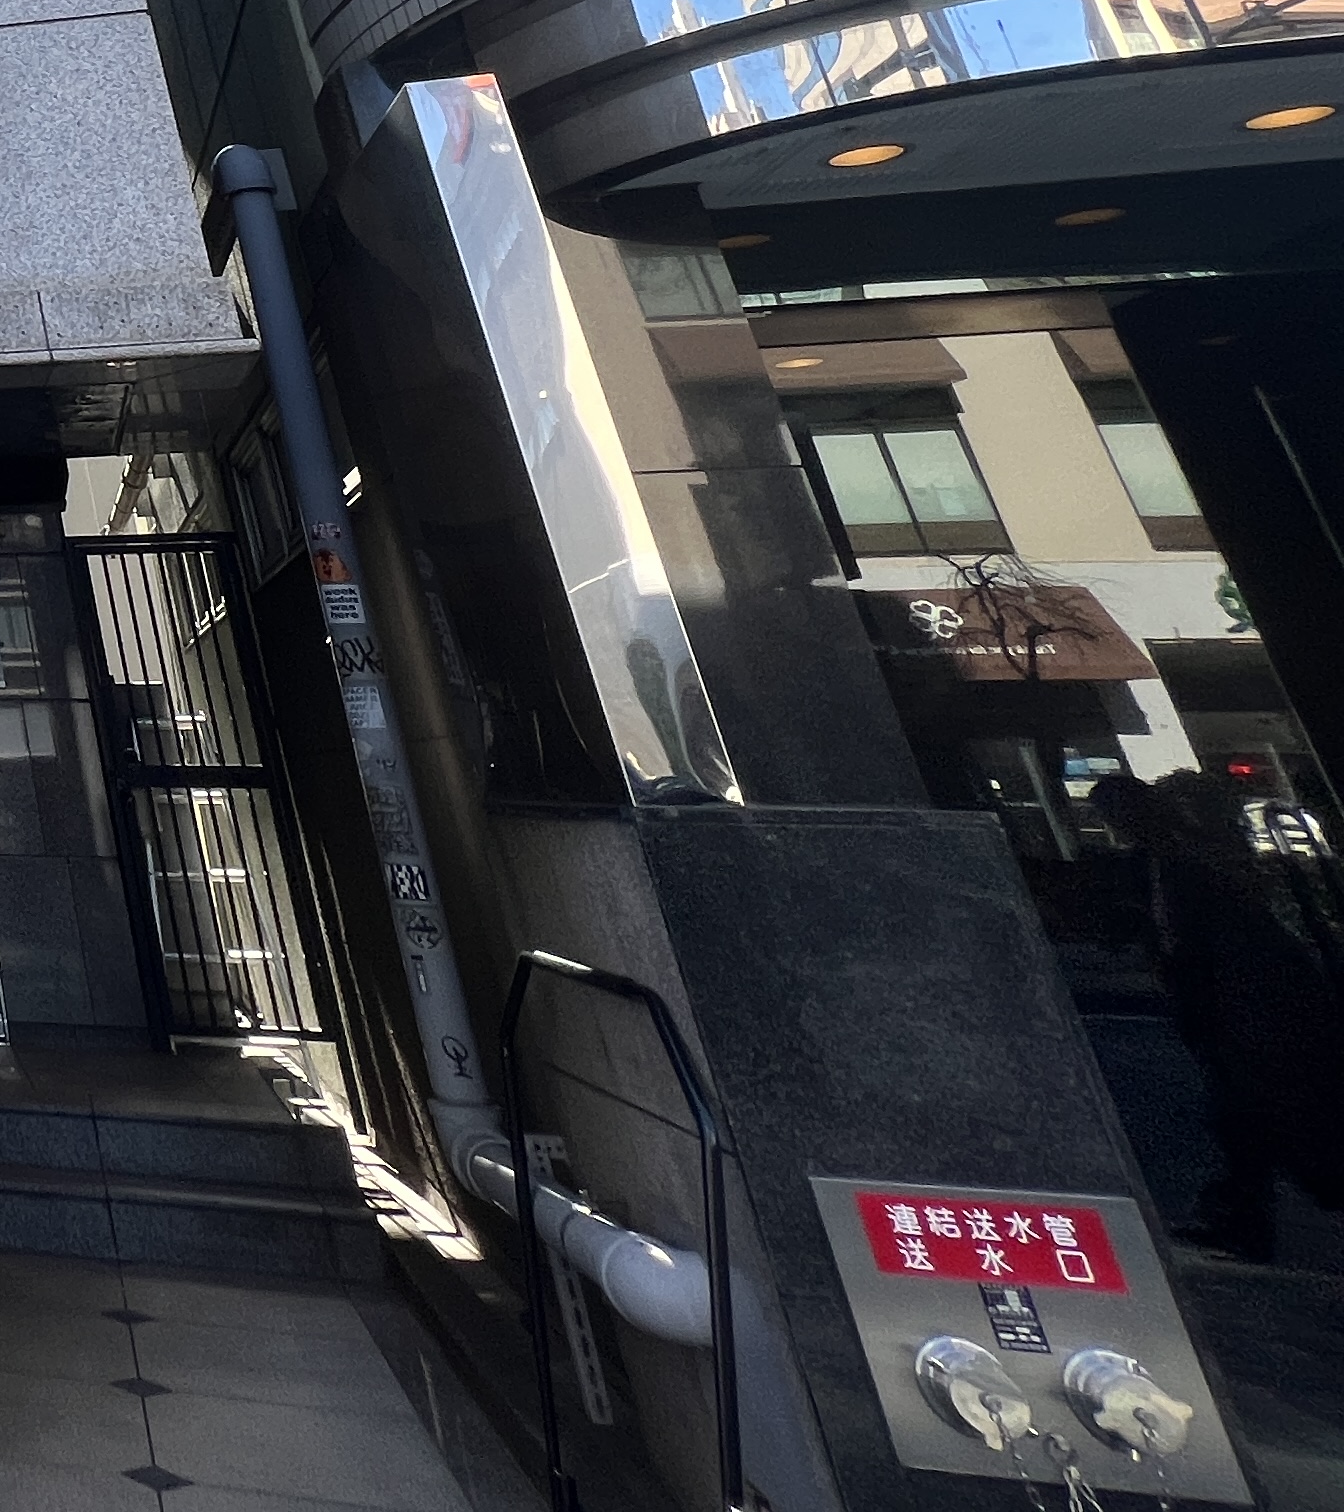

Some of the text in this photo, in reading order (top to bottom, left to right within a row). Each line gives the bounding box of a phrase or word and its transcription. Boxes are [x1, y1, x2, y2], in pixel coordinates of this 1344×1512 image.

[883, 1202, 1080, 1249] 連結送水管
[897, 1238, 1097, 1284] 送水口
